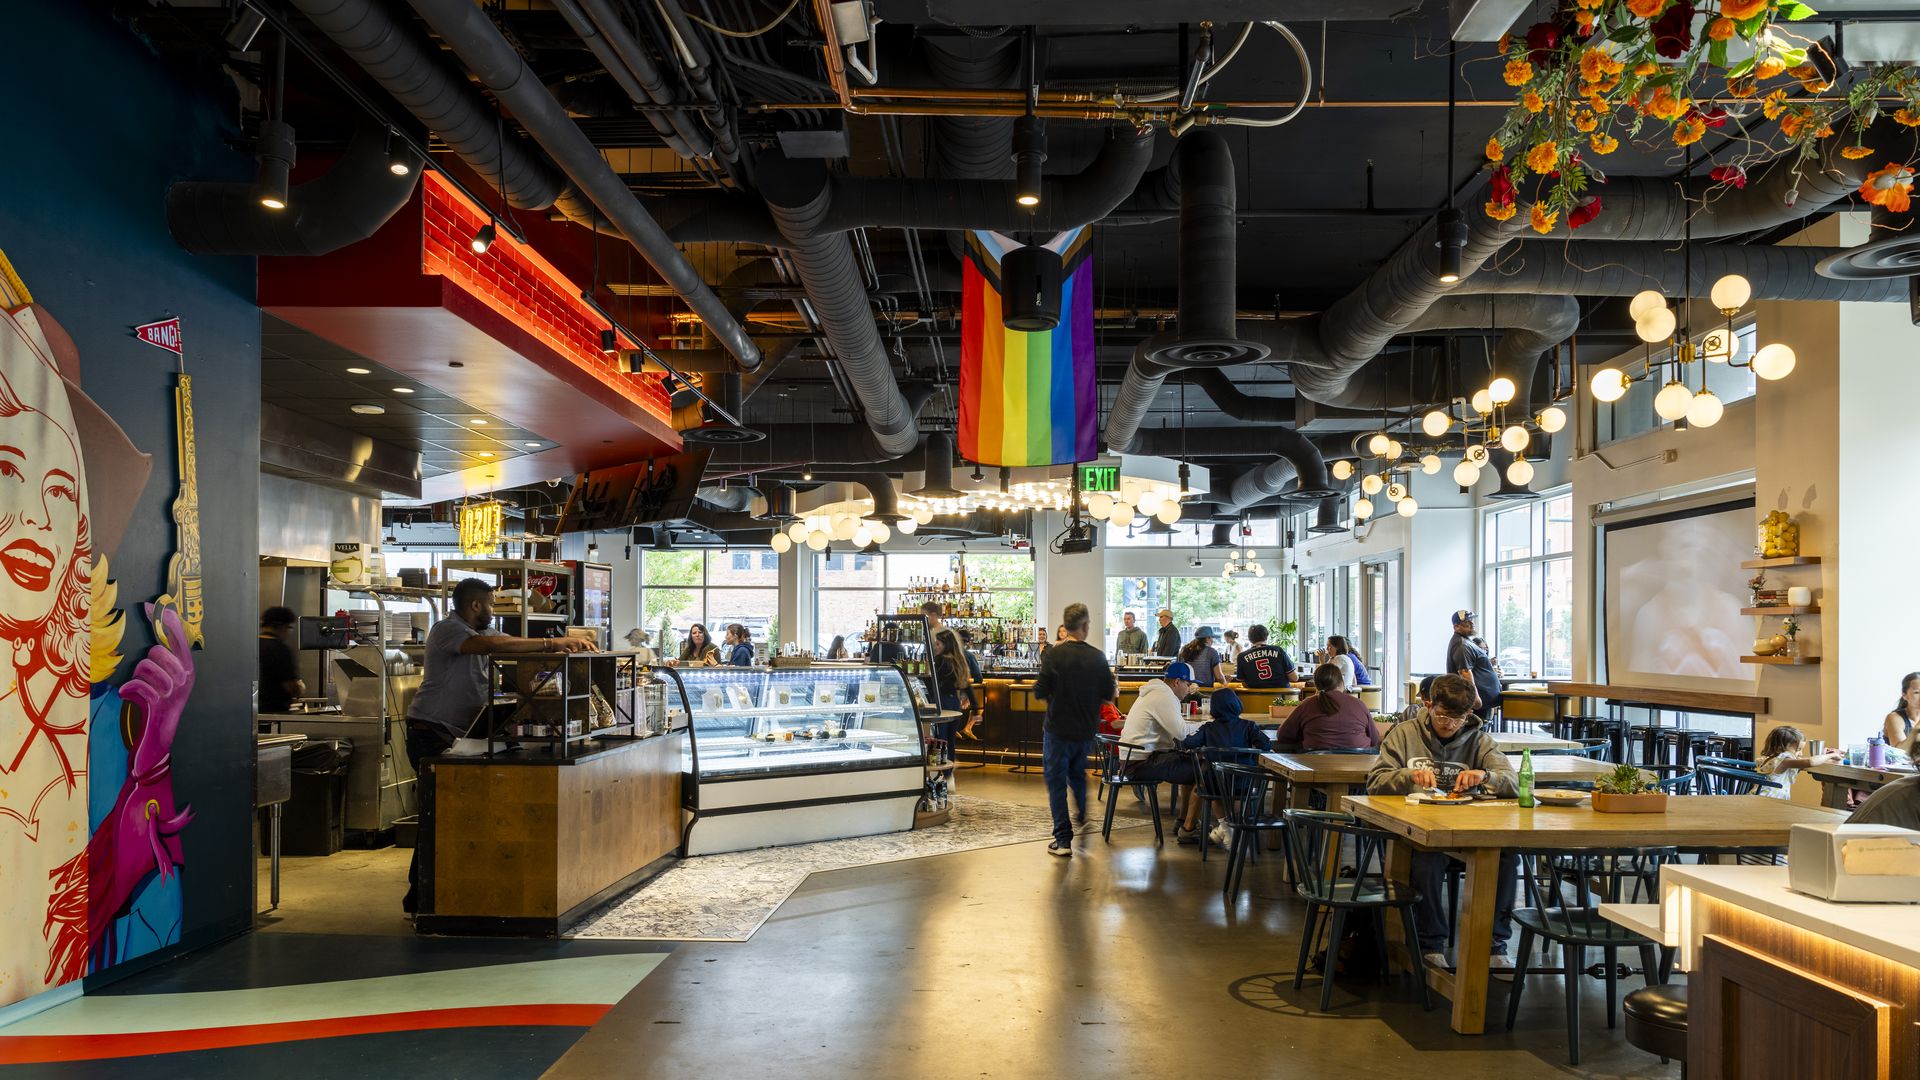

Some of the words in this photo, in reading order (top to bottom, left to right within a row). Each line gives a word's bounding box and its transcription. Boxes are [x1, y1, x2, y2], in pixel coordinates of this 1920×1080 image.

[147, 325, 177, 347] BANG!
[1085, 468, 1117, 491] EXIT
[1244, 649, 1279, 662] FREEMAN
[1255, 658, 1273, 680] 5
[1414, 761, 1441, 775] Shoe
[1442, 766, 1461, 776] Box
